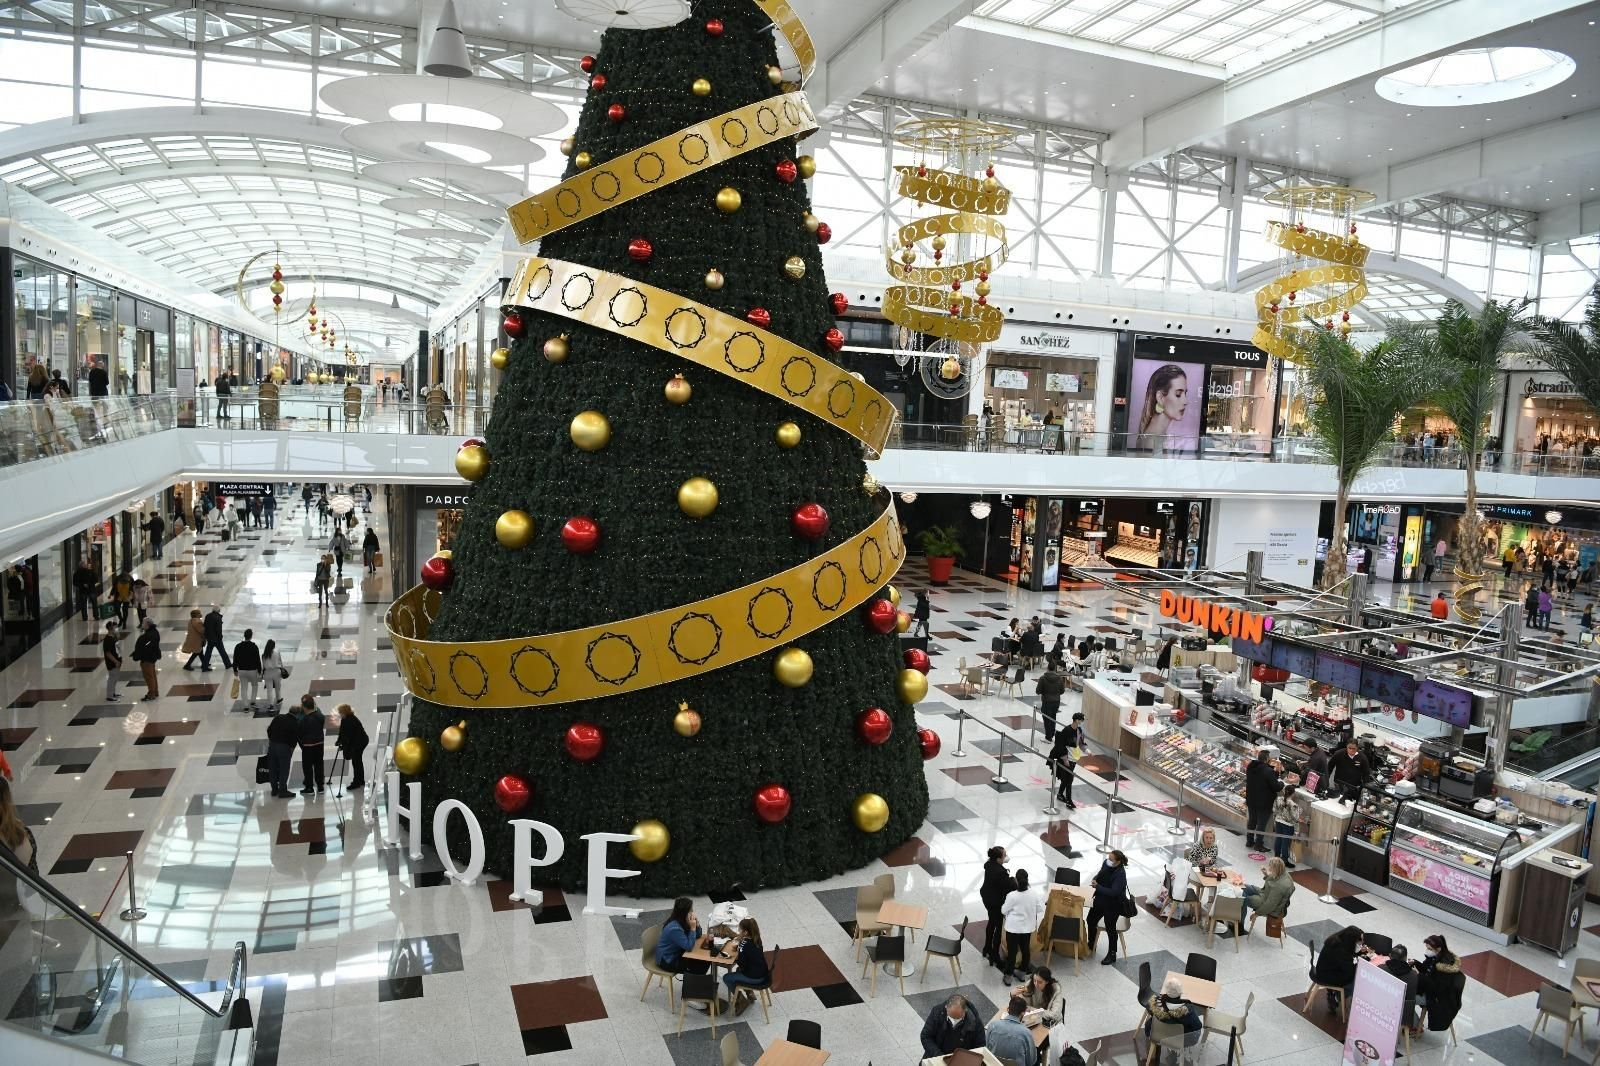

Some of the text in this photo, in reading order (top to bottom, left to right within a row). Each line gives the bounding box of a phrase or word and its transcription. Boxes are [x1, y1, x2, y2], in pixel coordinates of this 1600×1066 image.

[1234, 350, 1260, 361] TOUS
[425, 495, 469, 505] PARFO
[1496, 506, 1532, 517] PRIMARK
[384, 770, 645, 919] HOPE
[1355, 997, 1397, 1026] CHOCOLATE
